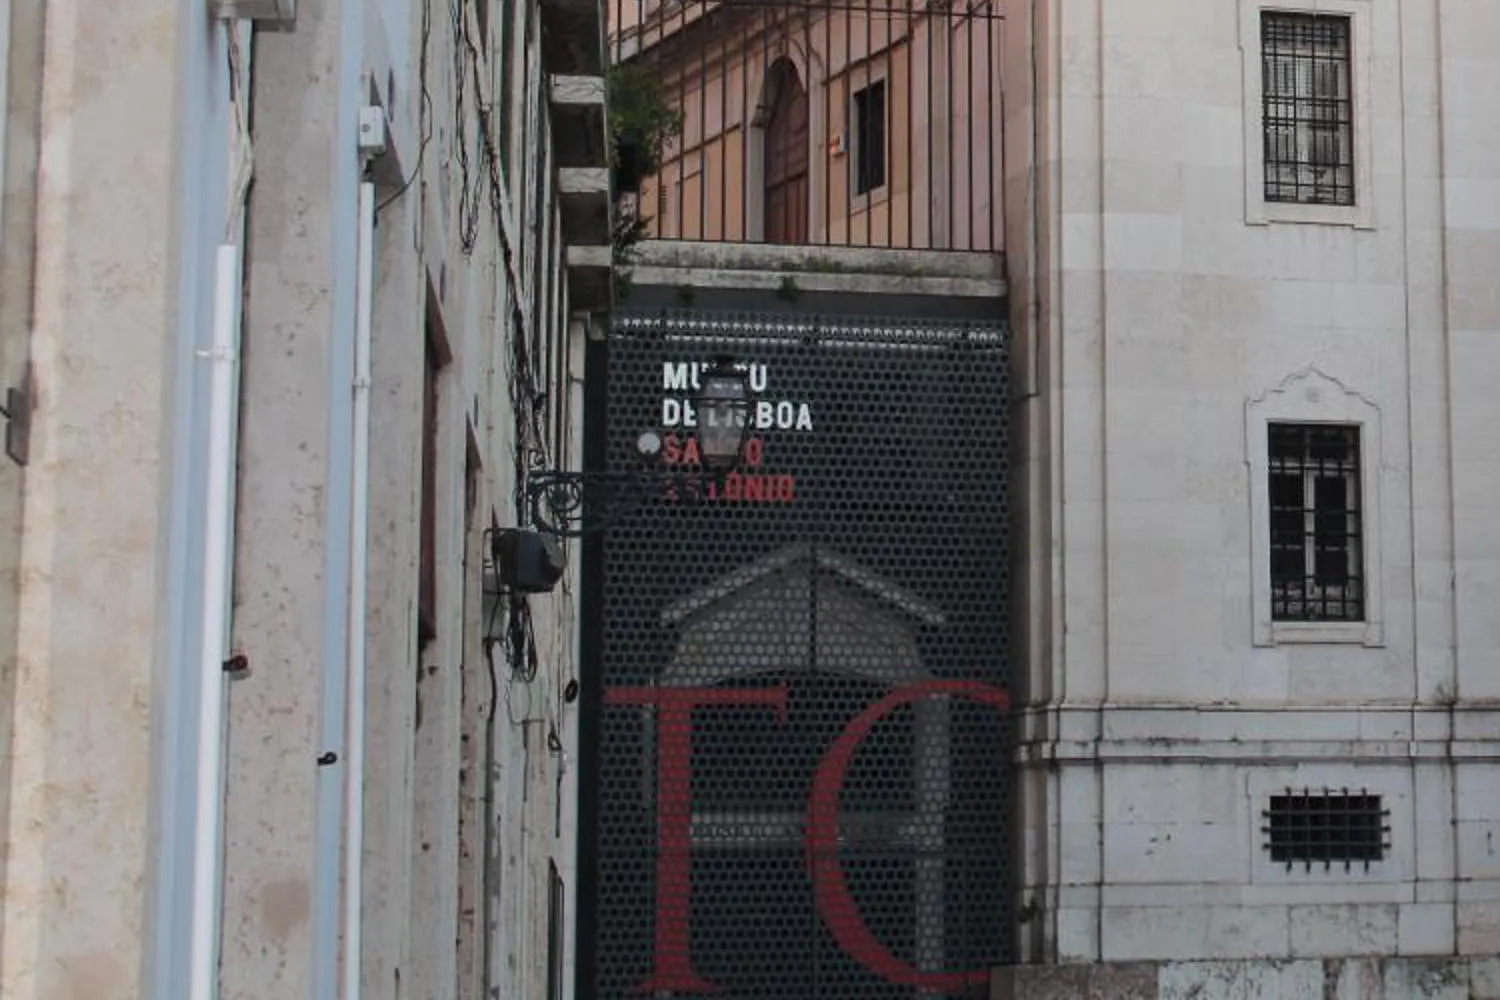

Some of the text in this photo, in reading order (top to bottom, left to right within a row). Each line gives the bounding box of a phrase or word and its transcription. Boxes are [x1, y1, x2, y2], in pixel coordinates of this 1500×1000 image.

[663, 361, 768, 392] MUU
[663, 398, 698, 427] DE
[662, 434, 765, 466] SAO
